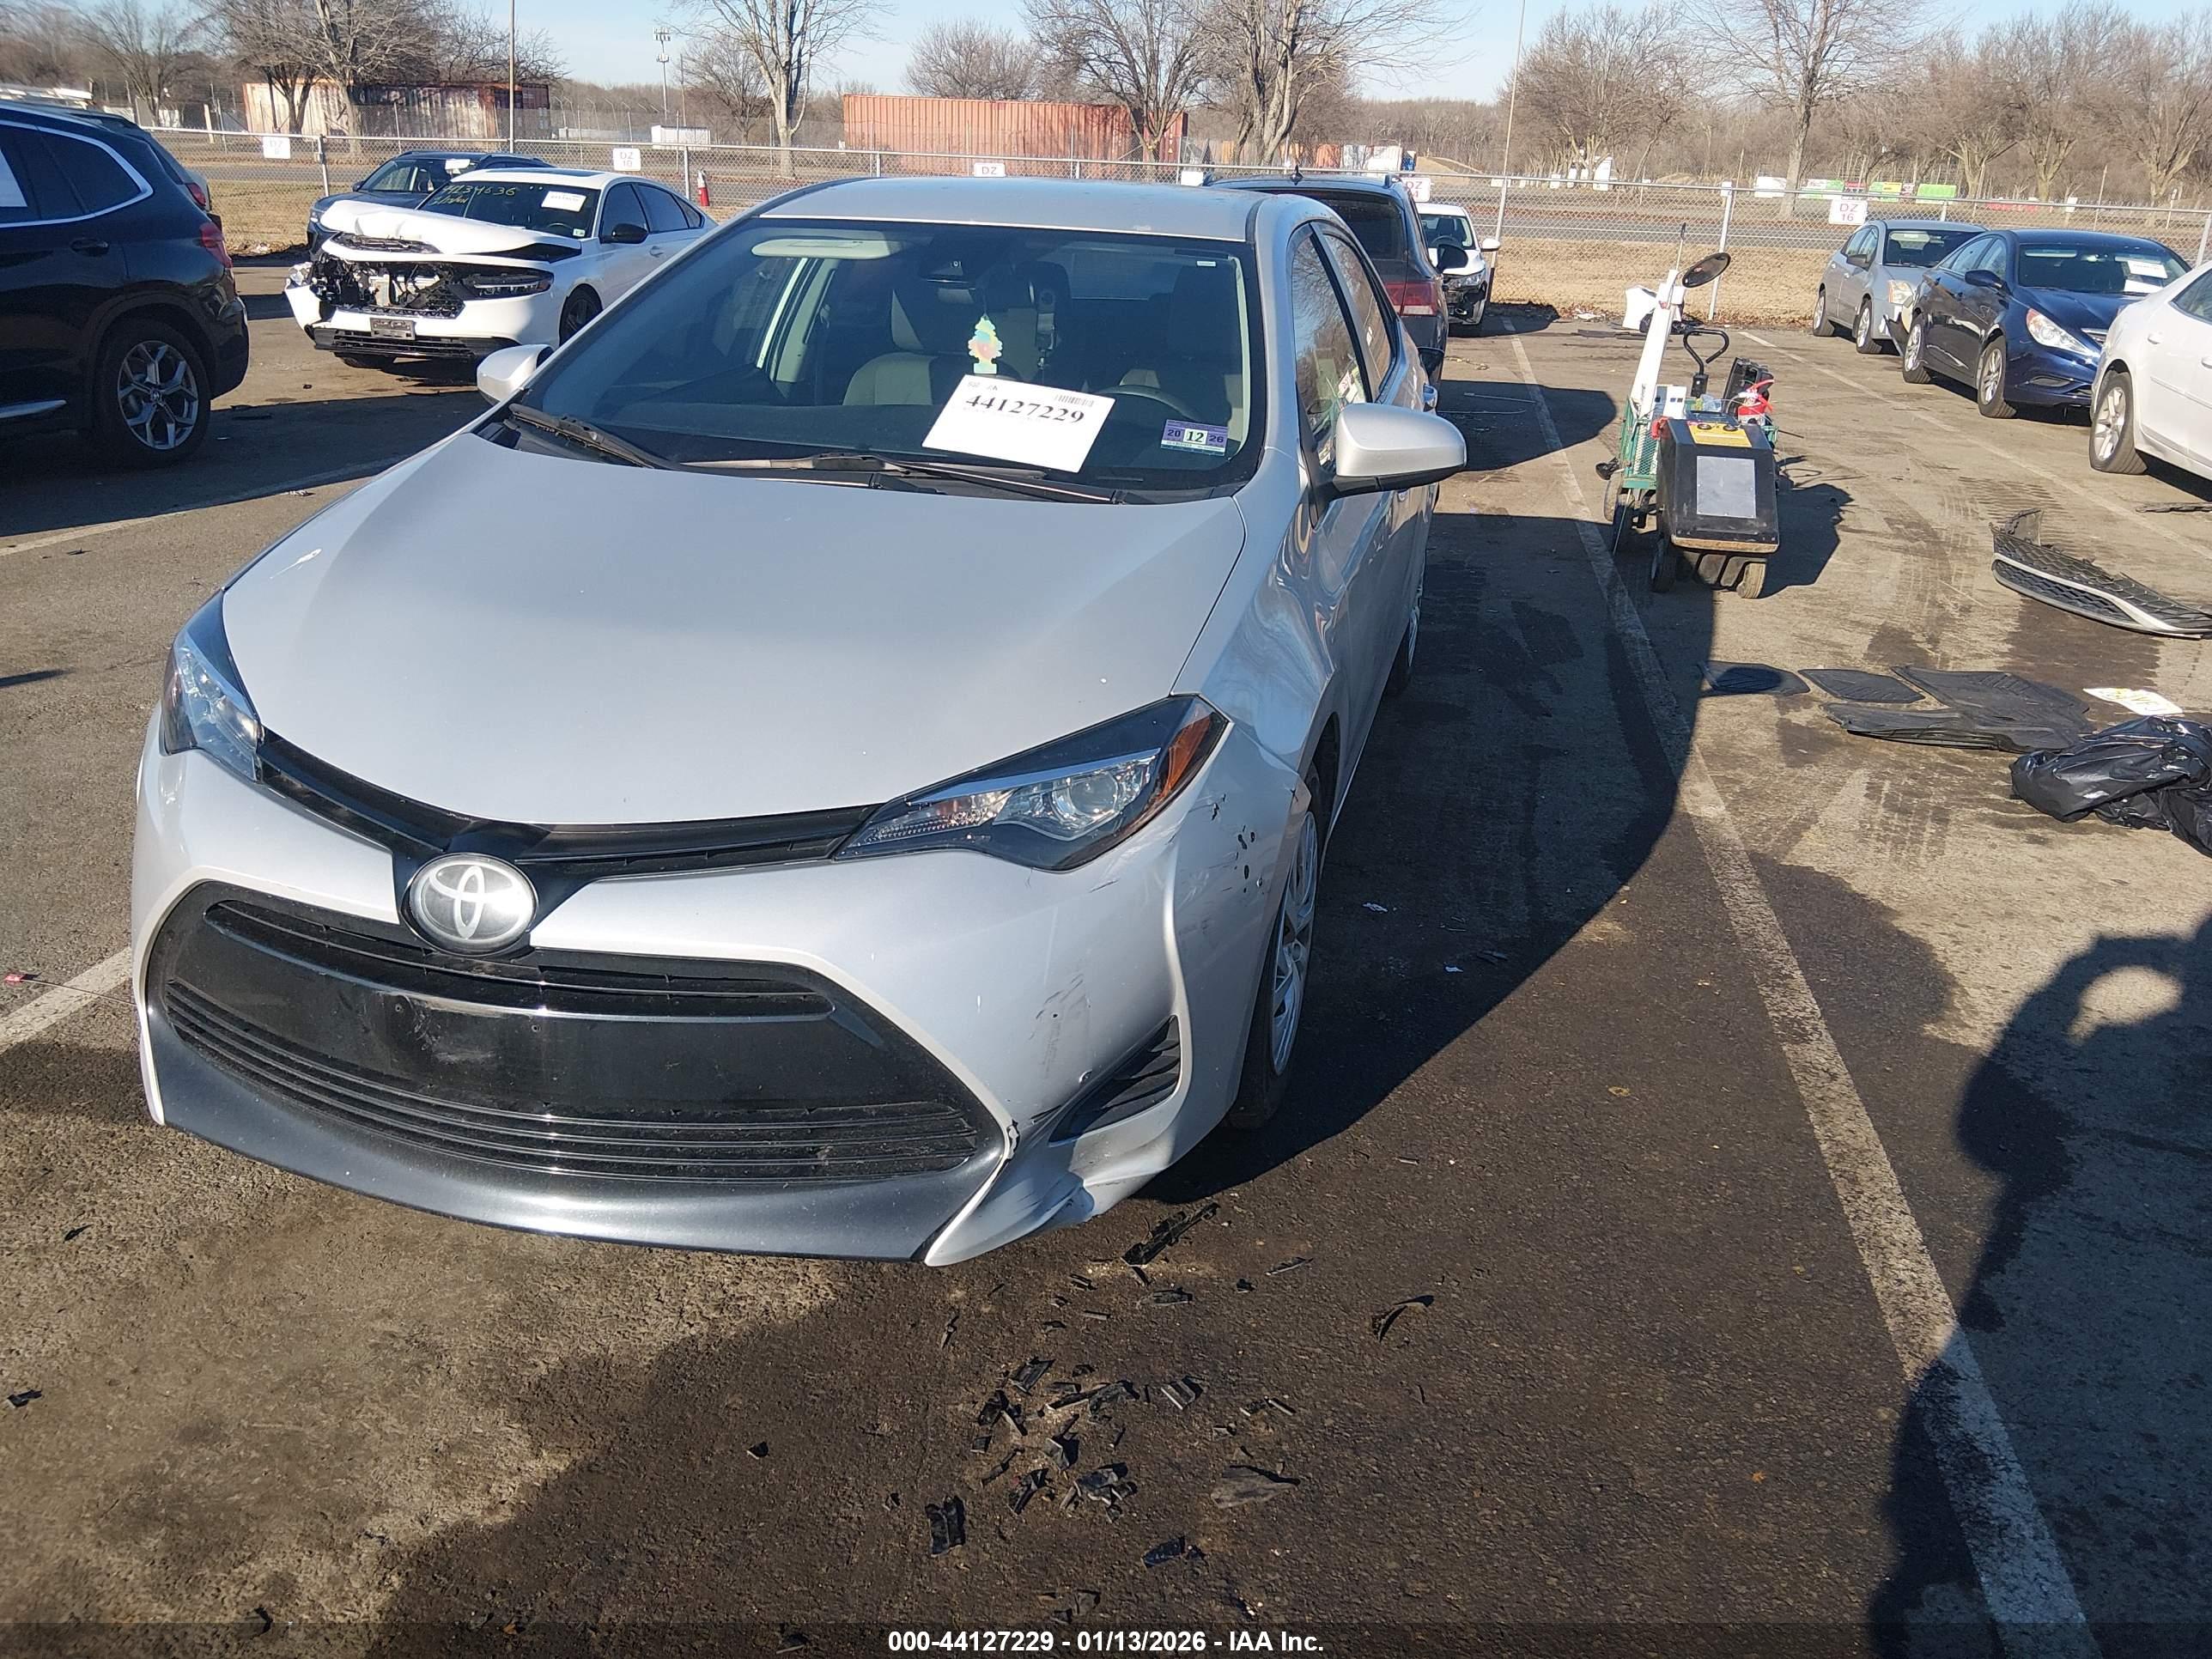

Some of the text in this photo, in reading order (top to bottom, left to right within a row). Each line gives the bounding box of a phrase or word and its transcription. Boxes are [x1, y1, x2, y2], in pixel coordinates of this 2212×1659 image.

[981, 167, 997, 175] DZ
[1840, 203, 1859, 212] DZ
[965, 394, 1085, 424] 44127229
[1187, 431, 1204, 443] 12
[1208, 434, 1224, 443] 26
